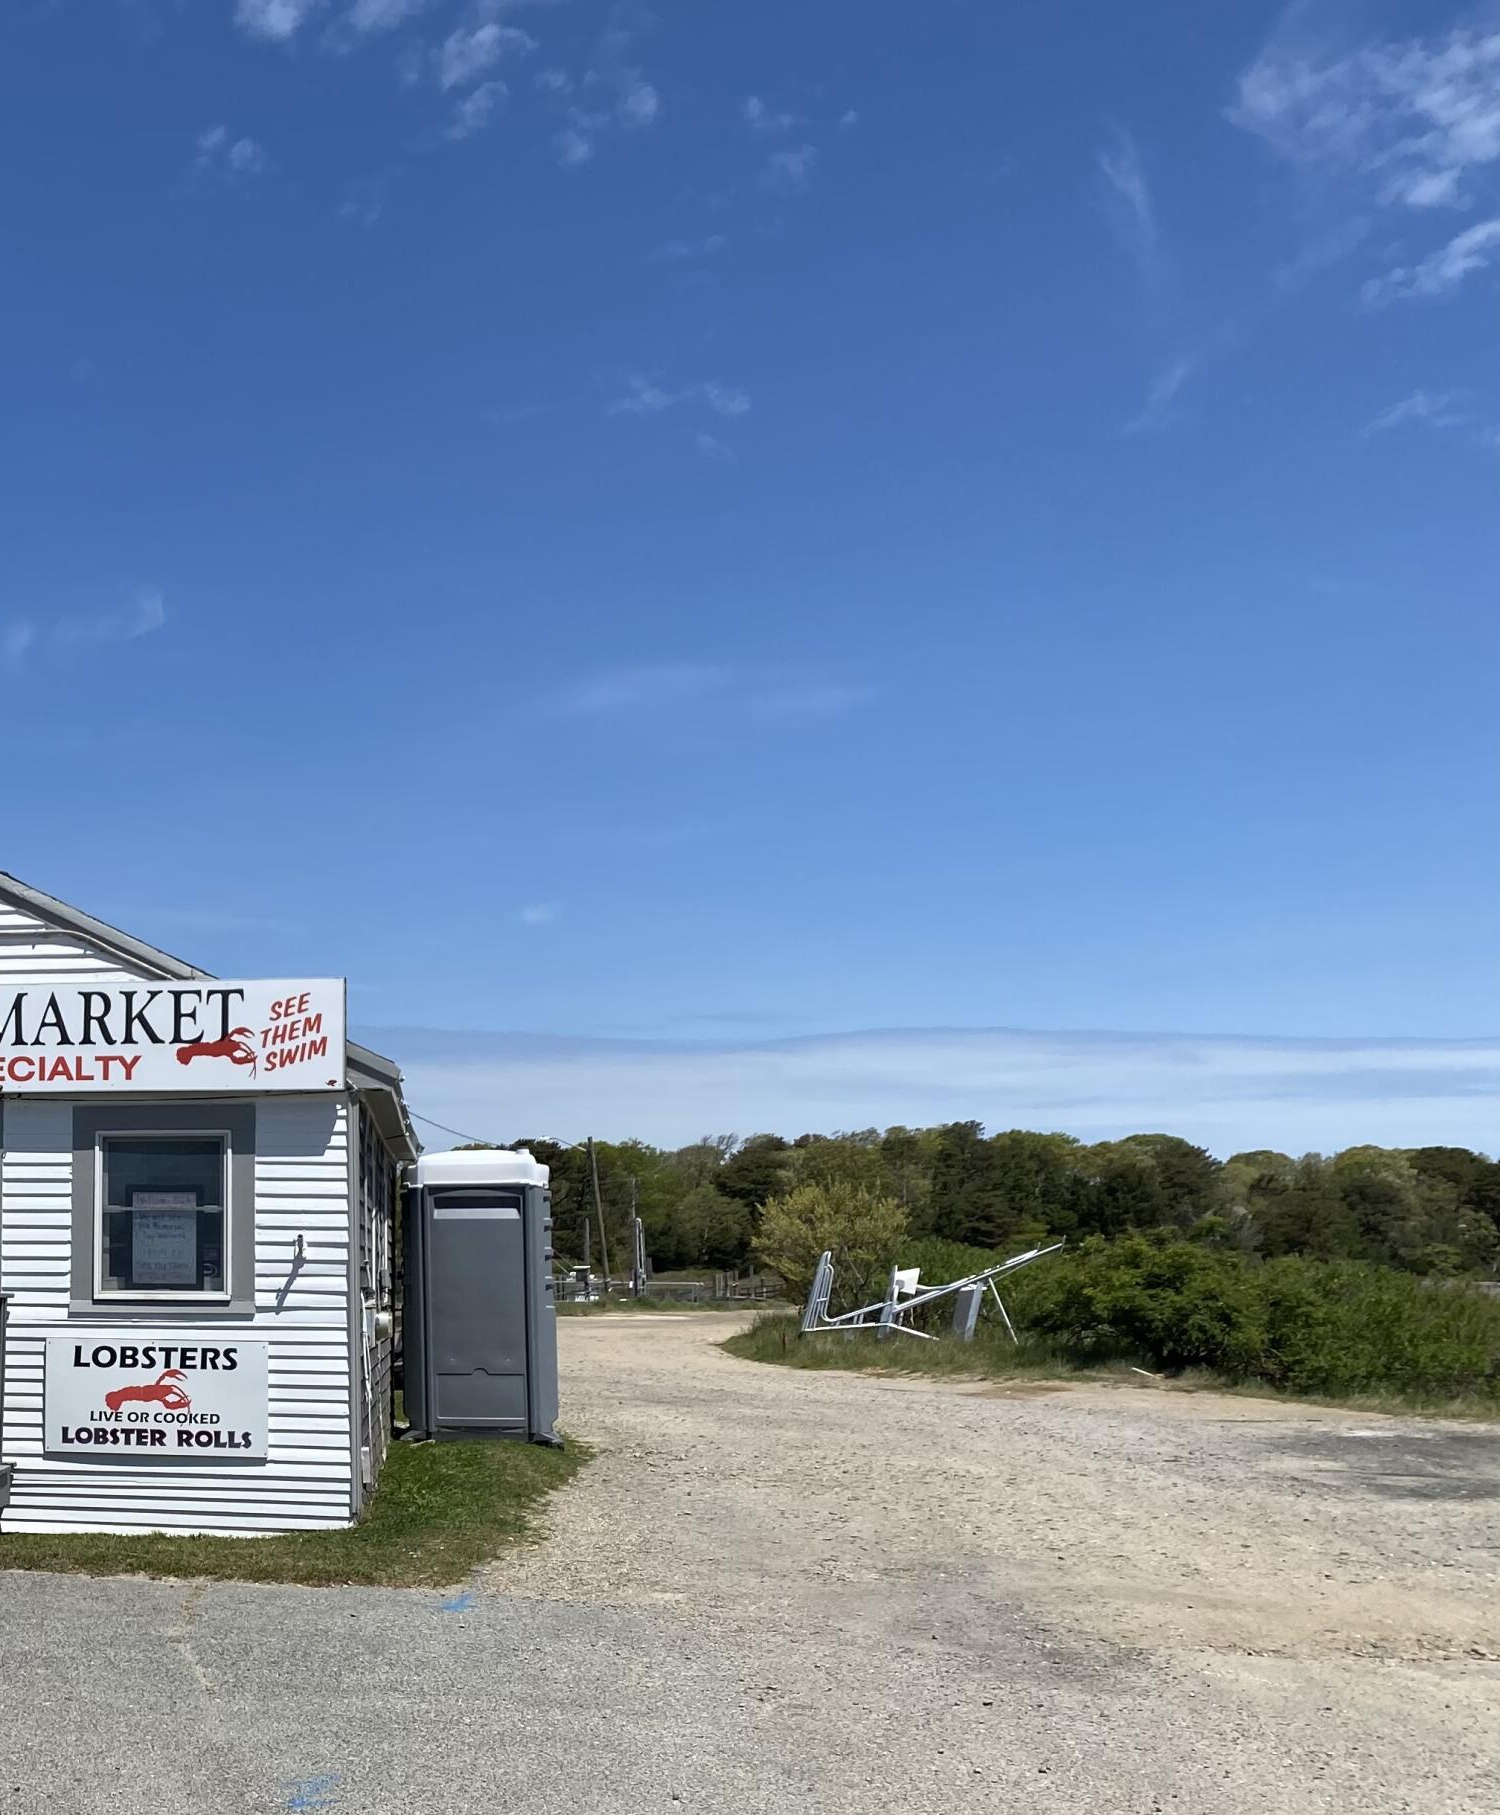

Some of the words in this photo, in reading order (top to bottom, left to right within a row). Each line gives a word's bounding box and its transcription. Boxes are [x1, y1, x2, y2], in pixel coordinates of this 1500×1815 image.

[269, 992, 311, 1021] SEE
[260, 1013, 322, 1048] THEM
[264, 1036, 328, 1071] SWIM
[73, 1345, 238, 1371] LOBSTERS
[90, 1411, 123, 1422] LIVE
[127, 1411, 150, 1423] OR
[154, 1412, 221, 1425] COOKED
[61, 1426, 167, 1447] LOBSTER
[176, 1429, 252, 1449] ROLLS
